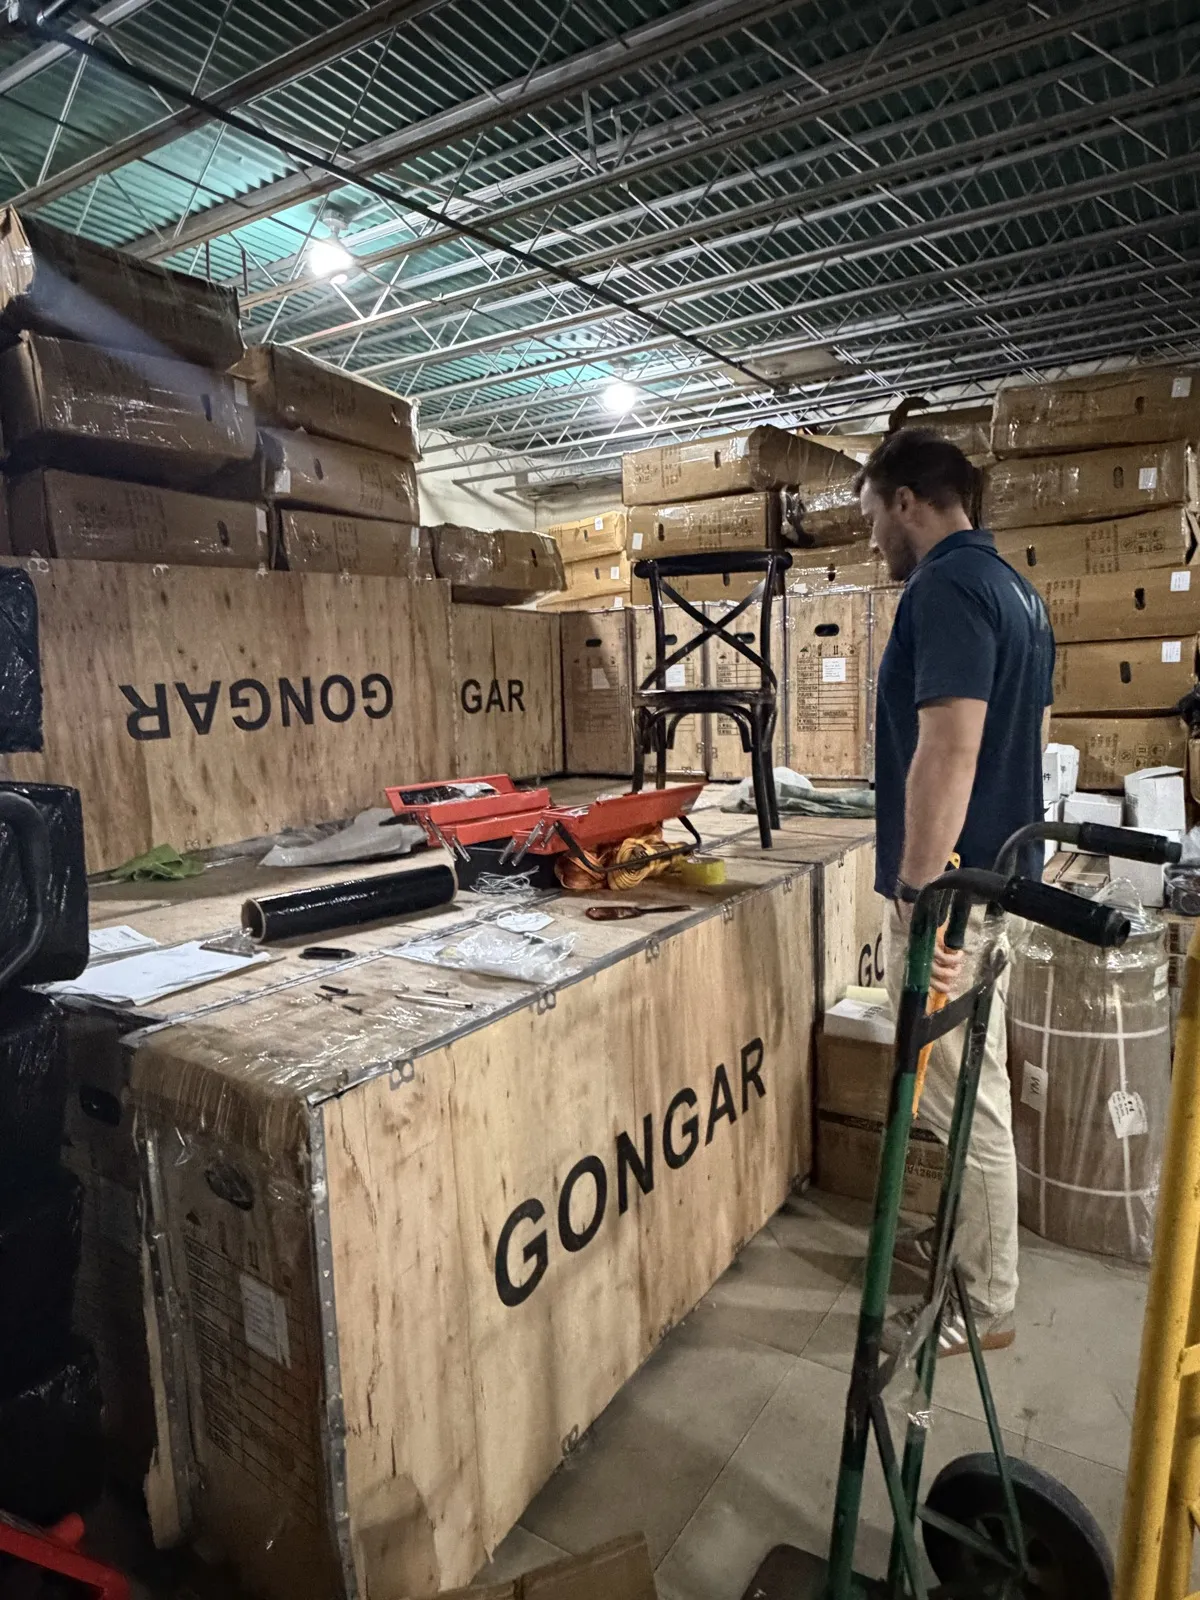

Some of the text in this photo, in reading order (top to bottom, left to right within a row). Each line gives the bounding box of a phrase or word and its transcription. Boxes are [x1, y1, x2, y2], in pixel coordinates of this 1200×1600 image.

[118, 673, 394, 741] GONGAR
[461, 678, 526, 714] GAR
[495, 1037, 767, 1307] GONGAR
